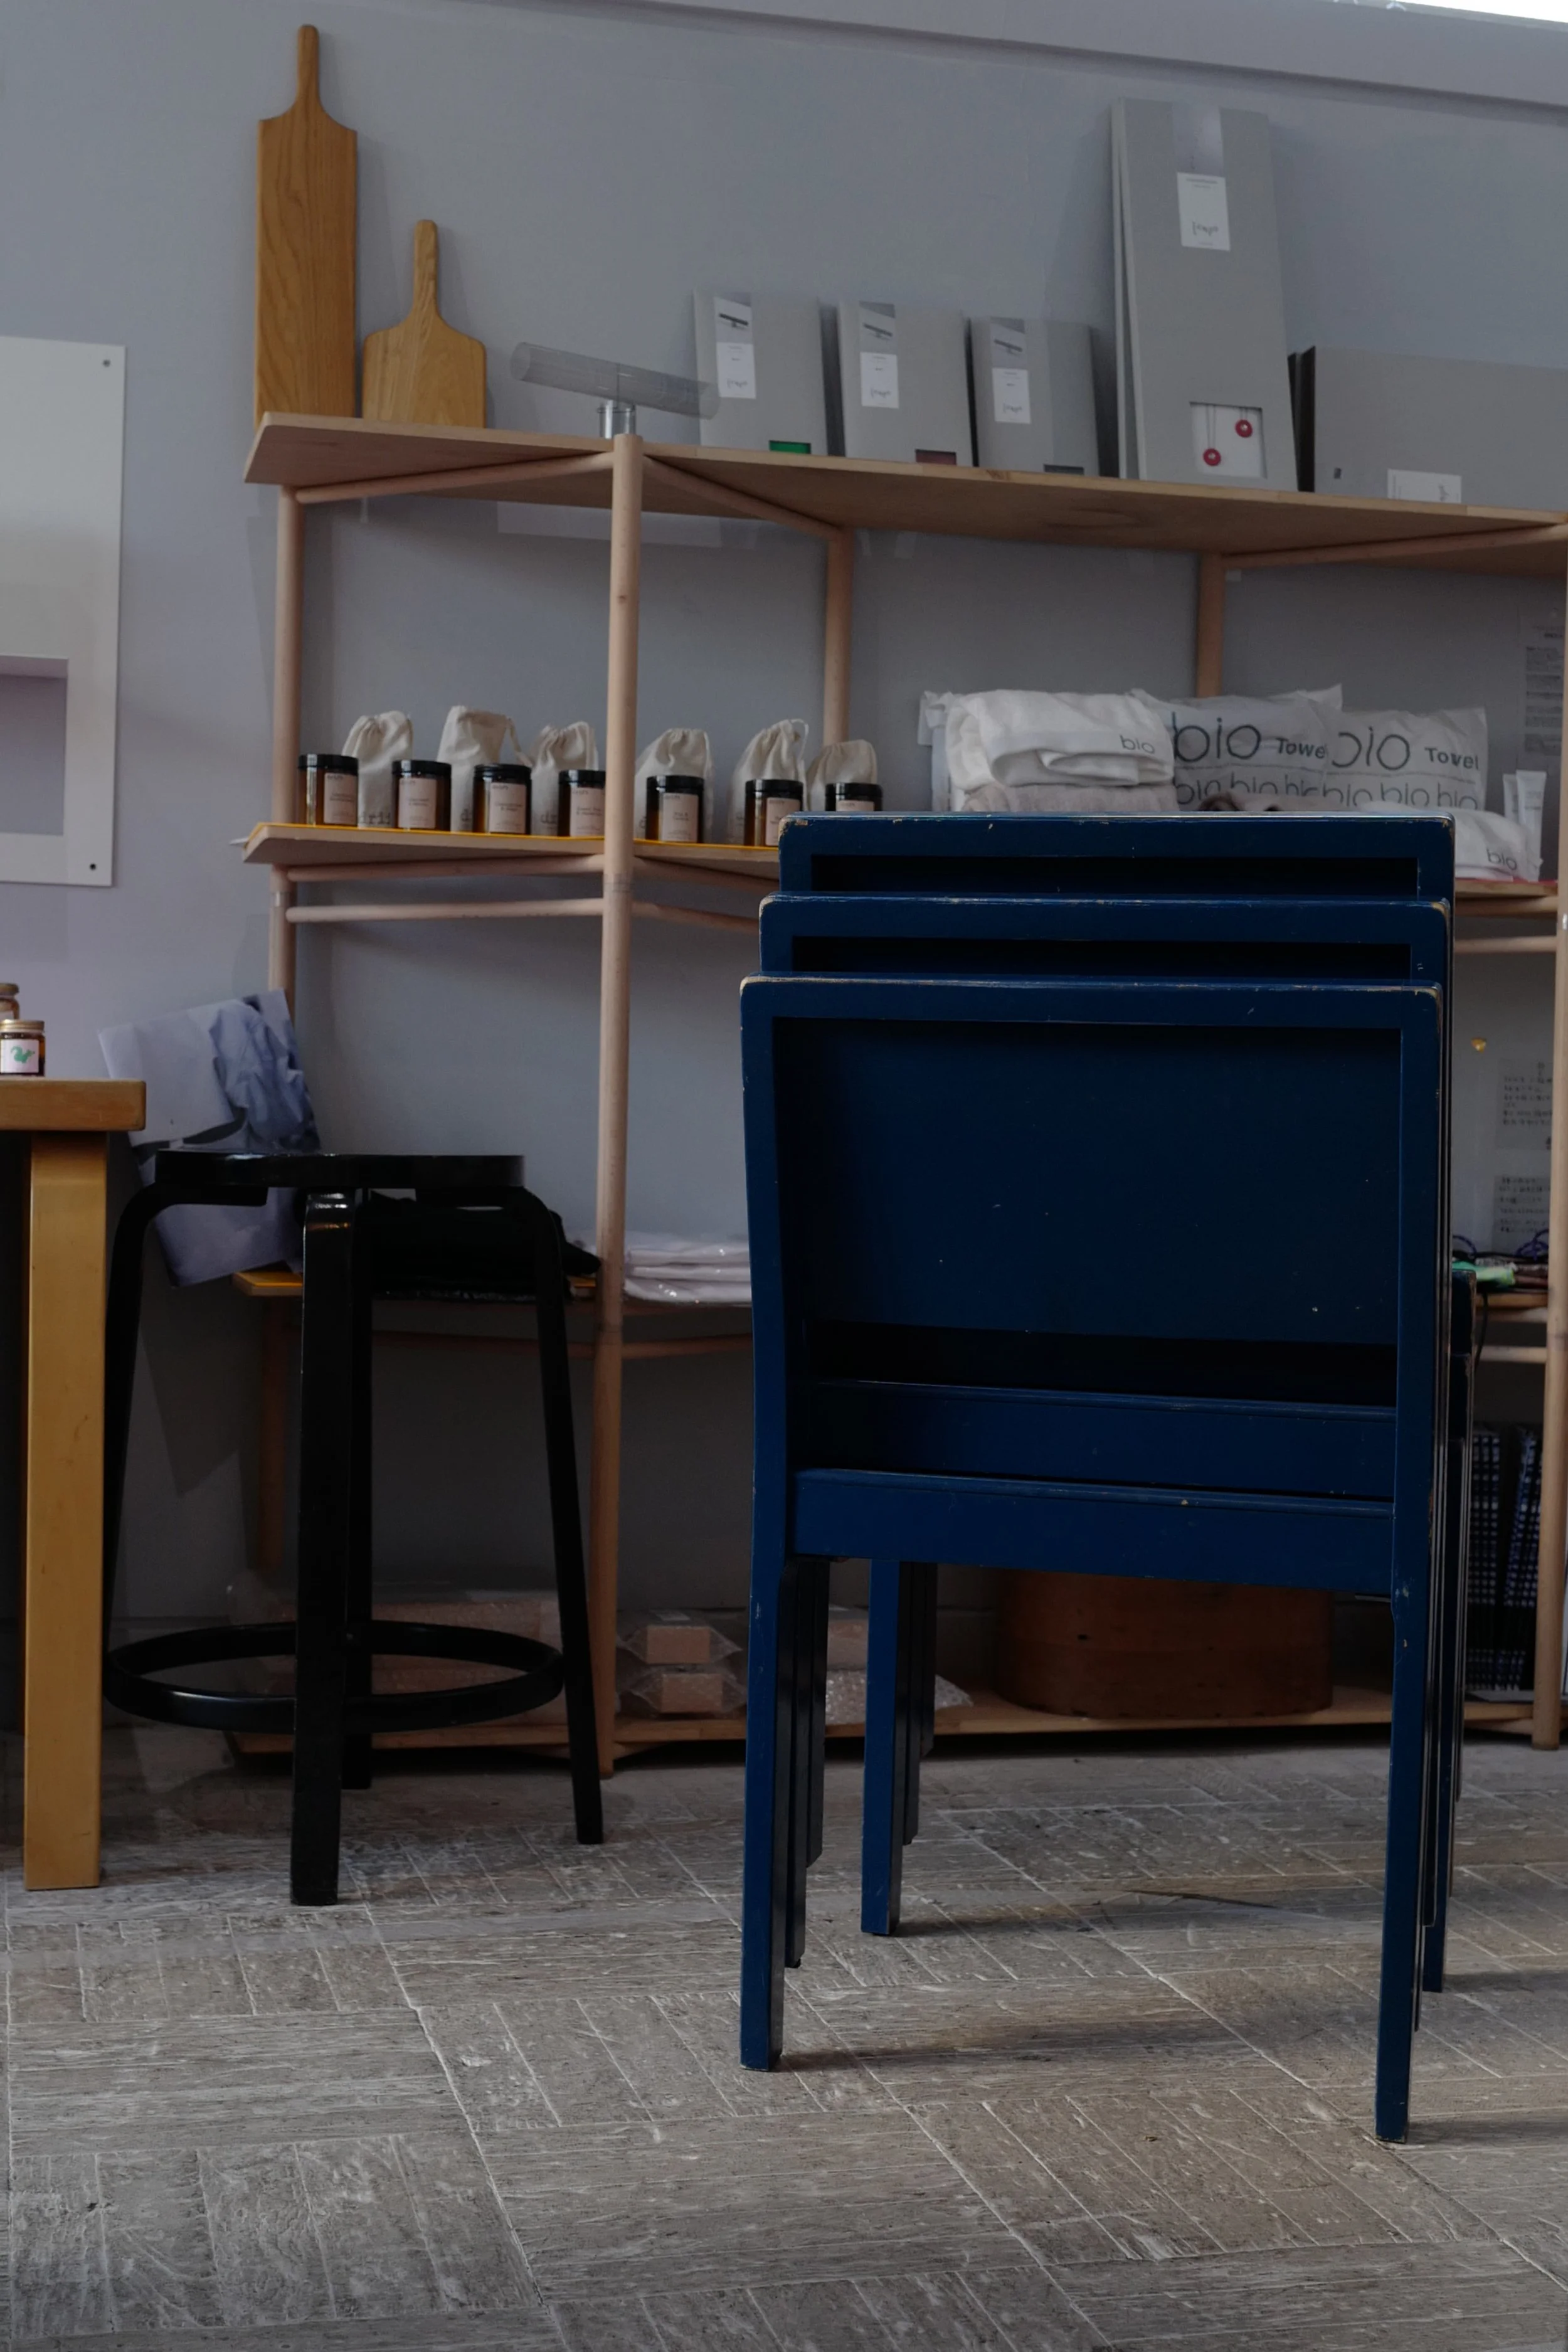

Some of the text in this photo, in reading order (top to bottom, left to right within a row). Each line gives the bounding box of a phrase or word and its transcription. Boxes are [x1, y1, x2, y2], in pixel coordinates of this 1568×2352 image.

[1120, 734, 1155, 755] bio
[1172, 711, 1327, 763] bio Towe
[1486, 848, 1518, 871] bio
